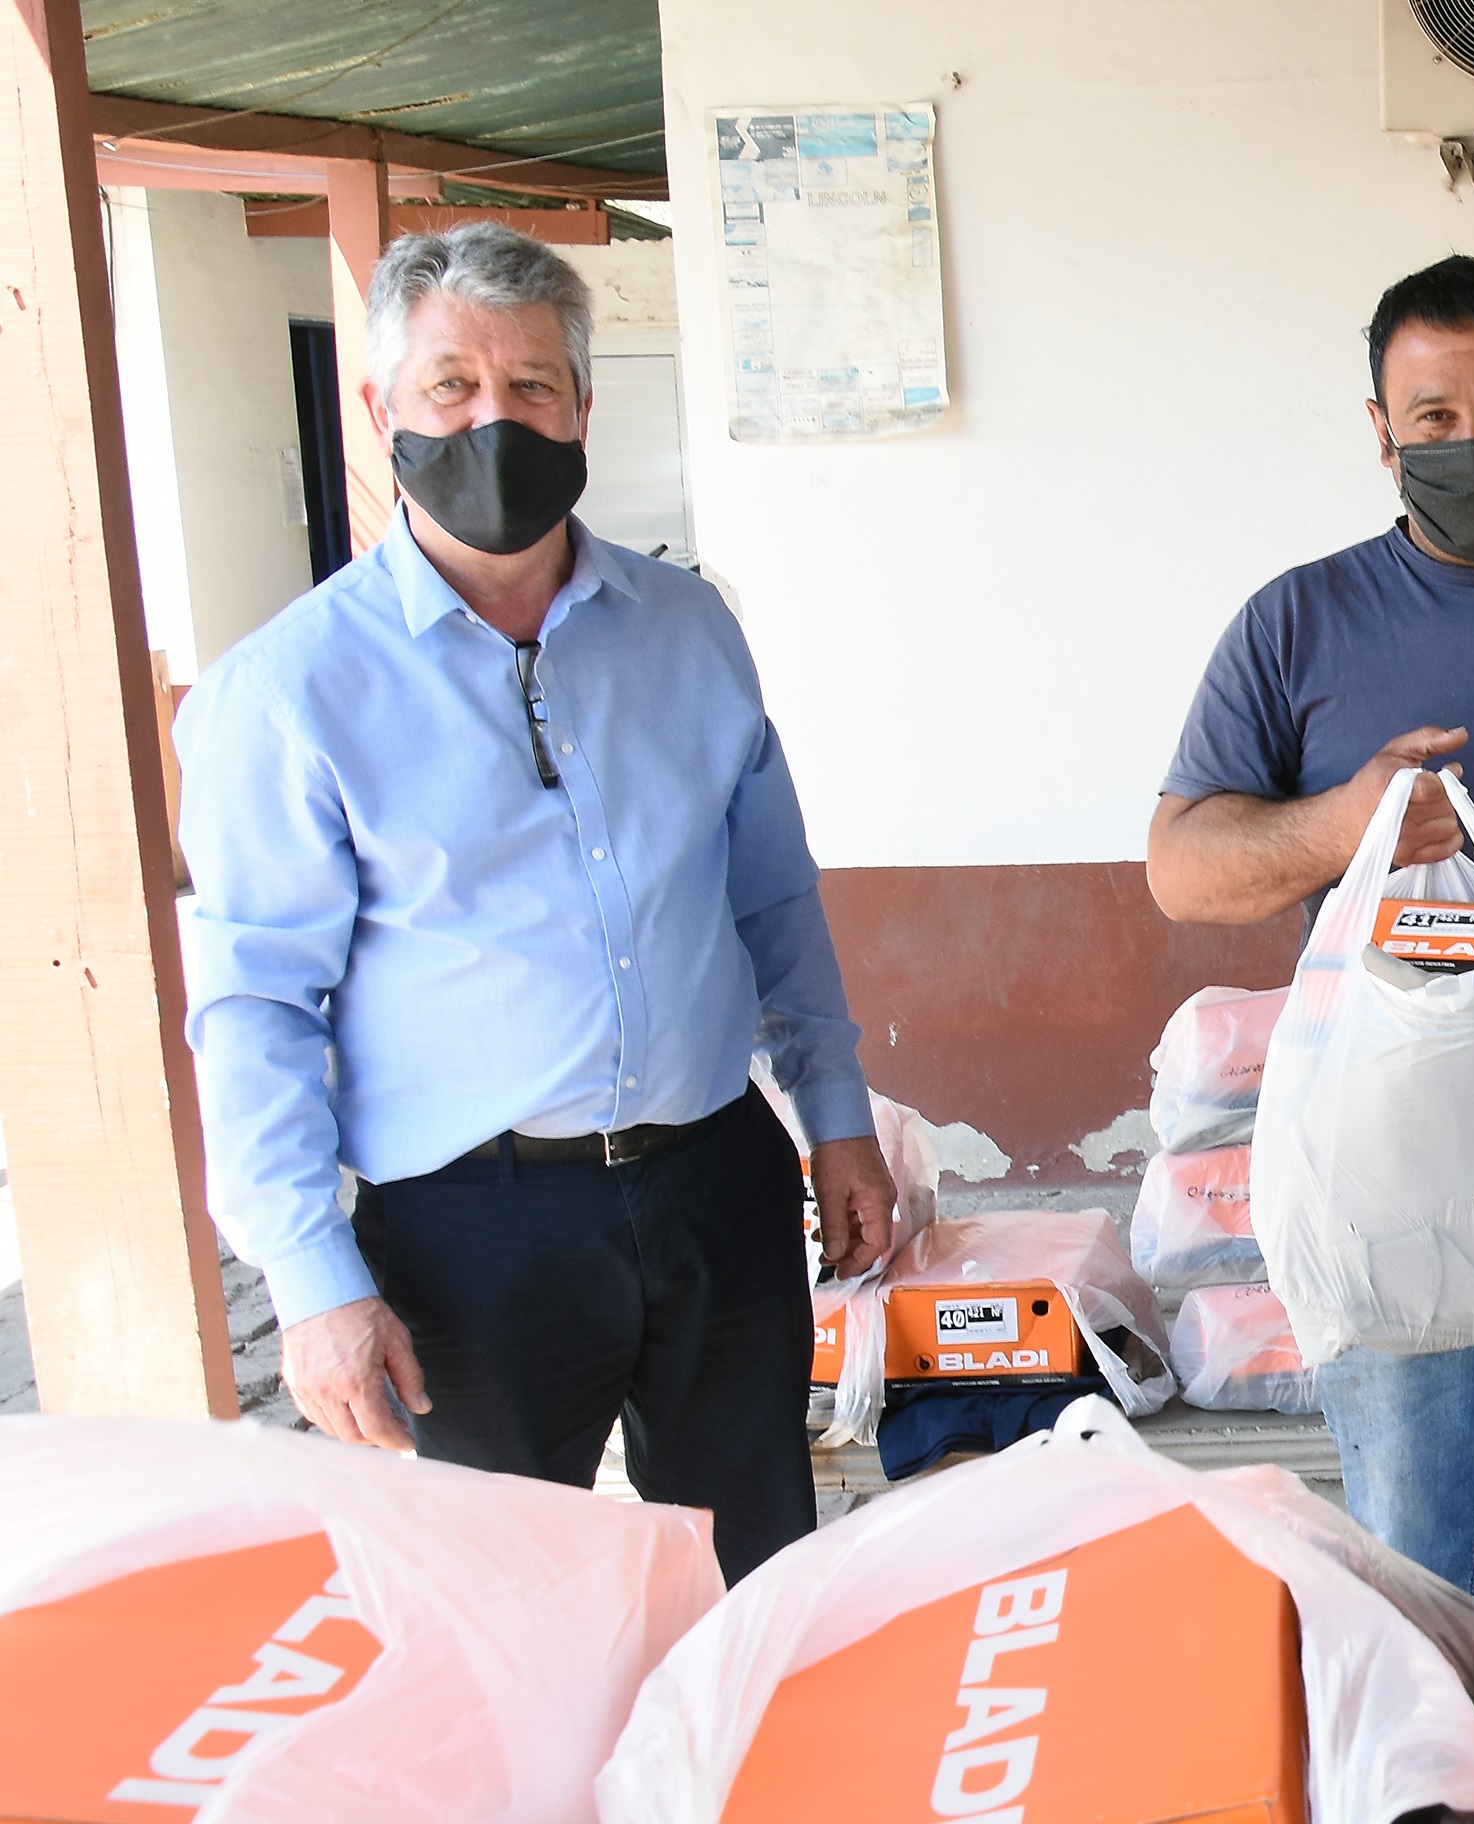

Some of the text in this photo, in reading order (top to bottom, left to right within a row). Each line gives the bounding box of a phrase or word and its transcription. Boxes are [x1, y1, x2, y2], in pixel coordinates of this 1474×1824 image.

[807, 190, 887, 208] LINCOLN
[1401, 914, 1431, 927] 41
[940, 1311, 966, 1329] 40
[938, 1349, 1049, 1371] BLADI
[106, 1570, 385, 1808] LADI
[930, 1567, 1069, 1824] BLAD
